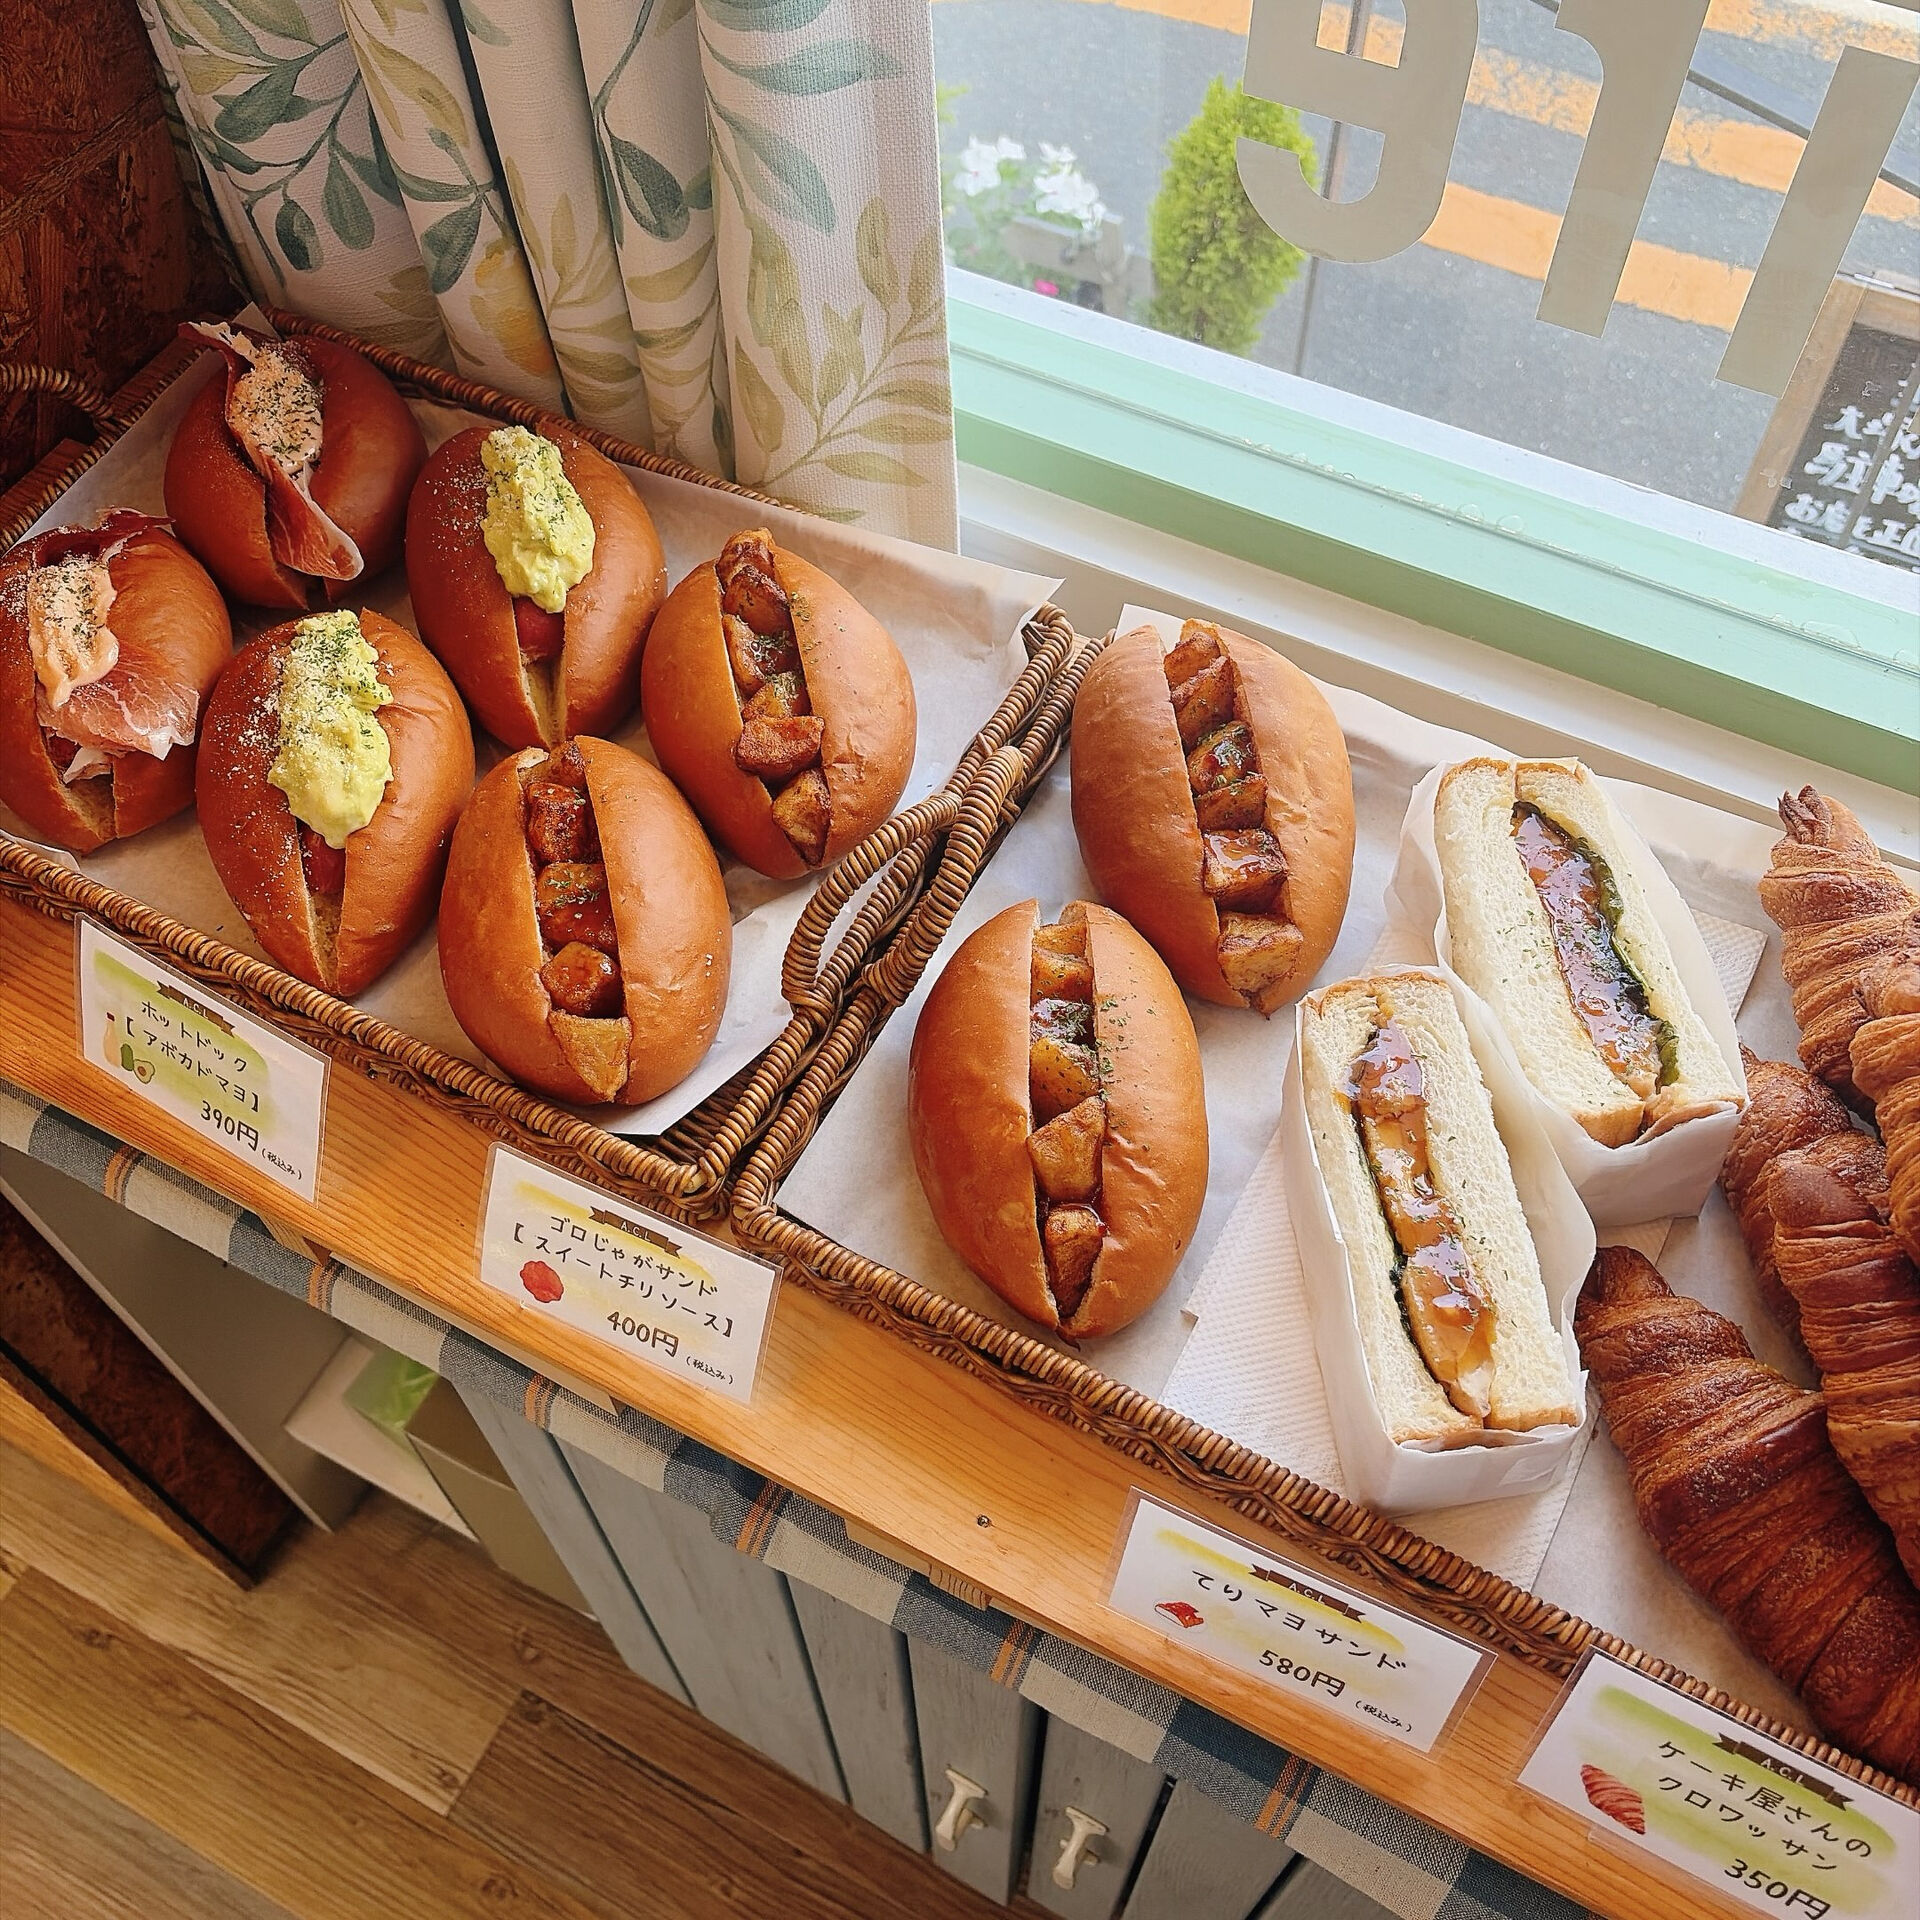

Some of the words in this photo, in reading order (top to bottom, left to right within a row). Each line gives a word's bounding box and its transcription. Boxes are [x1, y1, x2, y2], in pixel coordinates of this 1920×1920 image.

[126, 1017, 260, 1113] 【アボカドマヨ】
[142, 1001, 247, 1073] ホットドック
[200, 1099, 260, 1152] 390円
[513, 1222, 734, 1338] 【スイートチリソース】
[549, 1215, 718, 1297] ゴロじゃがサンド
[606, 1311, 679, 1358] 400円
[1192, 1570, 1407, 1671] てりマヨサンド
[1258, 1649, 1346, 1698] 580円
[1658, 1740, 1872, 1859] ケーキ屋さんの
[1658, 1776, 1838, 1872] クロワッサン
[1724, 1858, 1831, 1920] 350円
